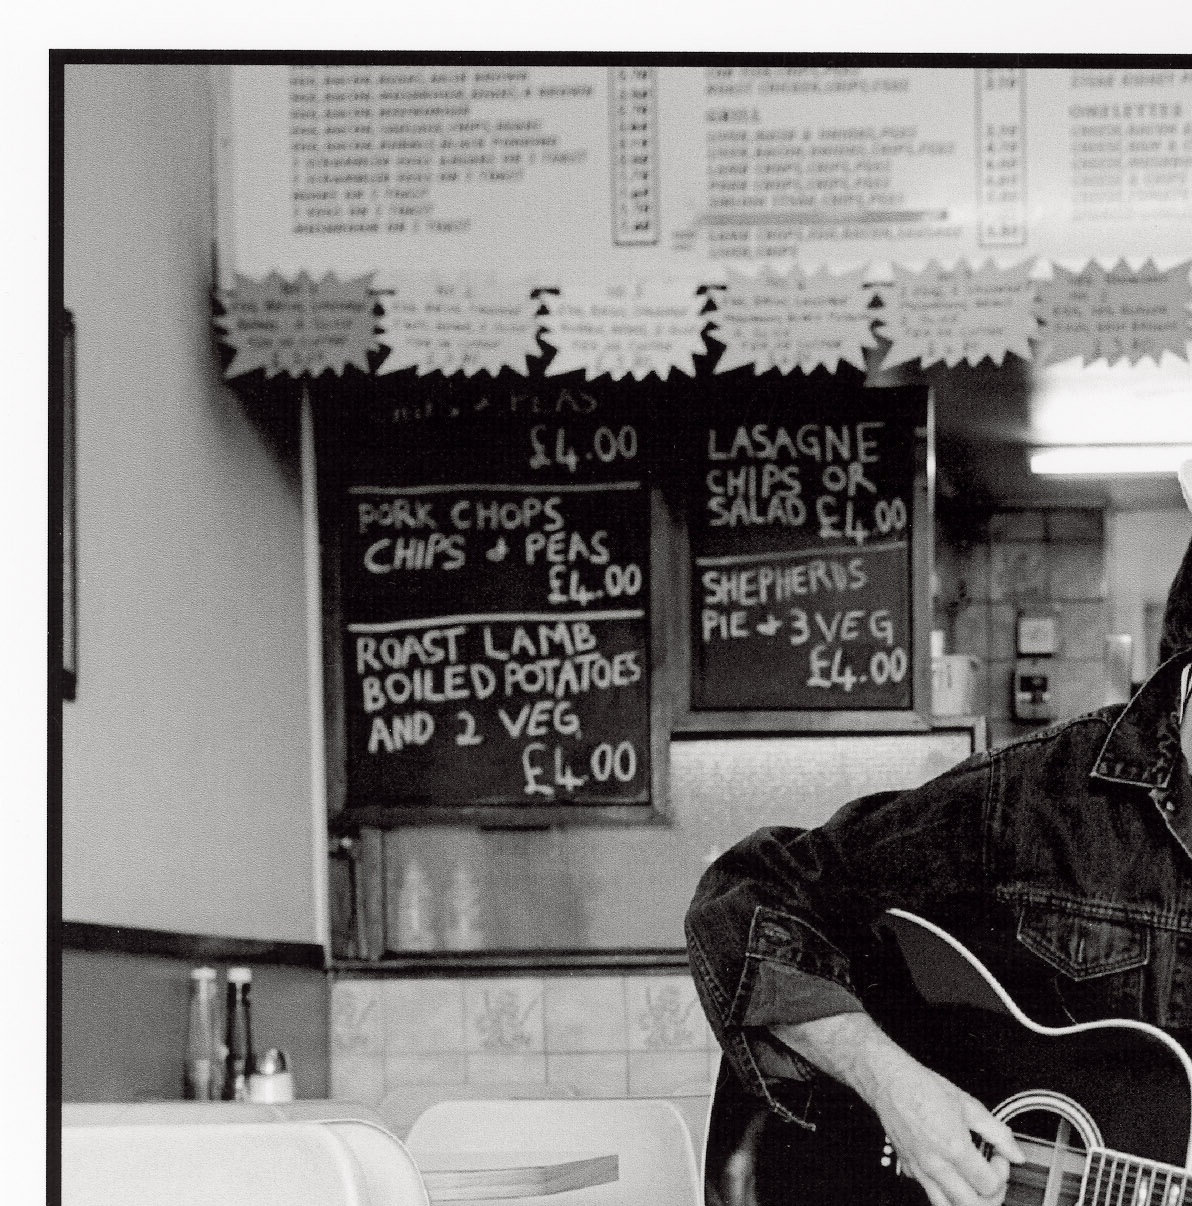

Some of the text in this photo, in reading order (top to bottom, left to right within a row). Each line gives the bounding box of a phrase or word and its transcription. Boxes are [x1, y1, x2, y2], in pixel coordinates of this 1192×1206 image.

[529, 424, 638, 473] £4.00
[707, 421, 886, 464] LASAGNE
[705, 461, 878, 498] CHIPS OR
[358, 497, 565, 534] PORK CHOPS
[707, 495, 807, 528] SALAD
[363, 532, 467, 574] CHIPS
[525, 530, 611, 566] PEAS
[547, 564, 643, 606] £4.00
[356, 622, 598, 675] ROAST LAMB
[701, 609, 750, 643] PIE
[789, 607, 811, 646] 3
[814, 609, 894, 647] VEG
[362, 652, 642, 713] BOILED POTATOES
[806, 644, 908, 692] £4.00
[367, 700, 583, 753] AND 2 VEG
[522, 740, 638, 796] £4.00
